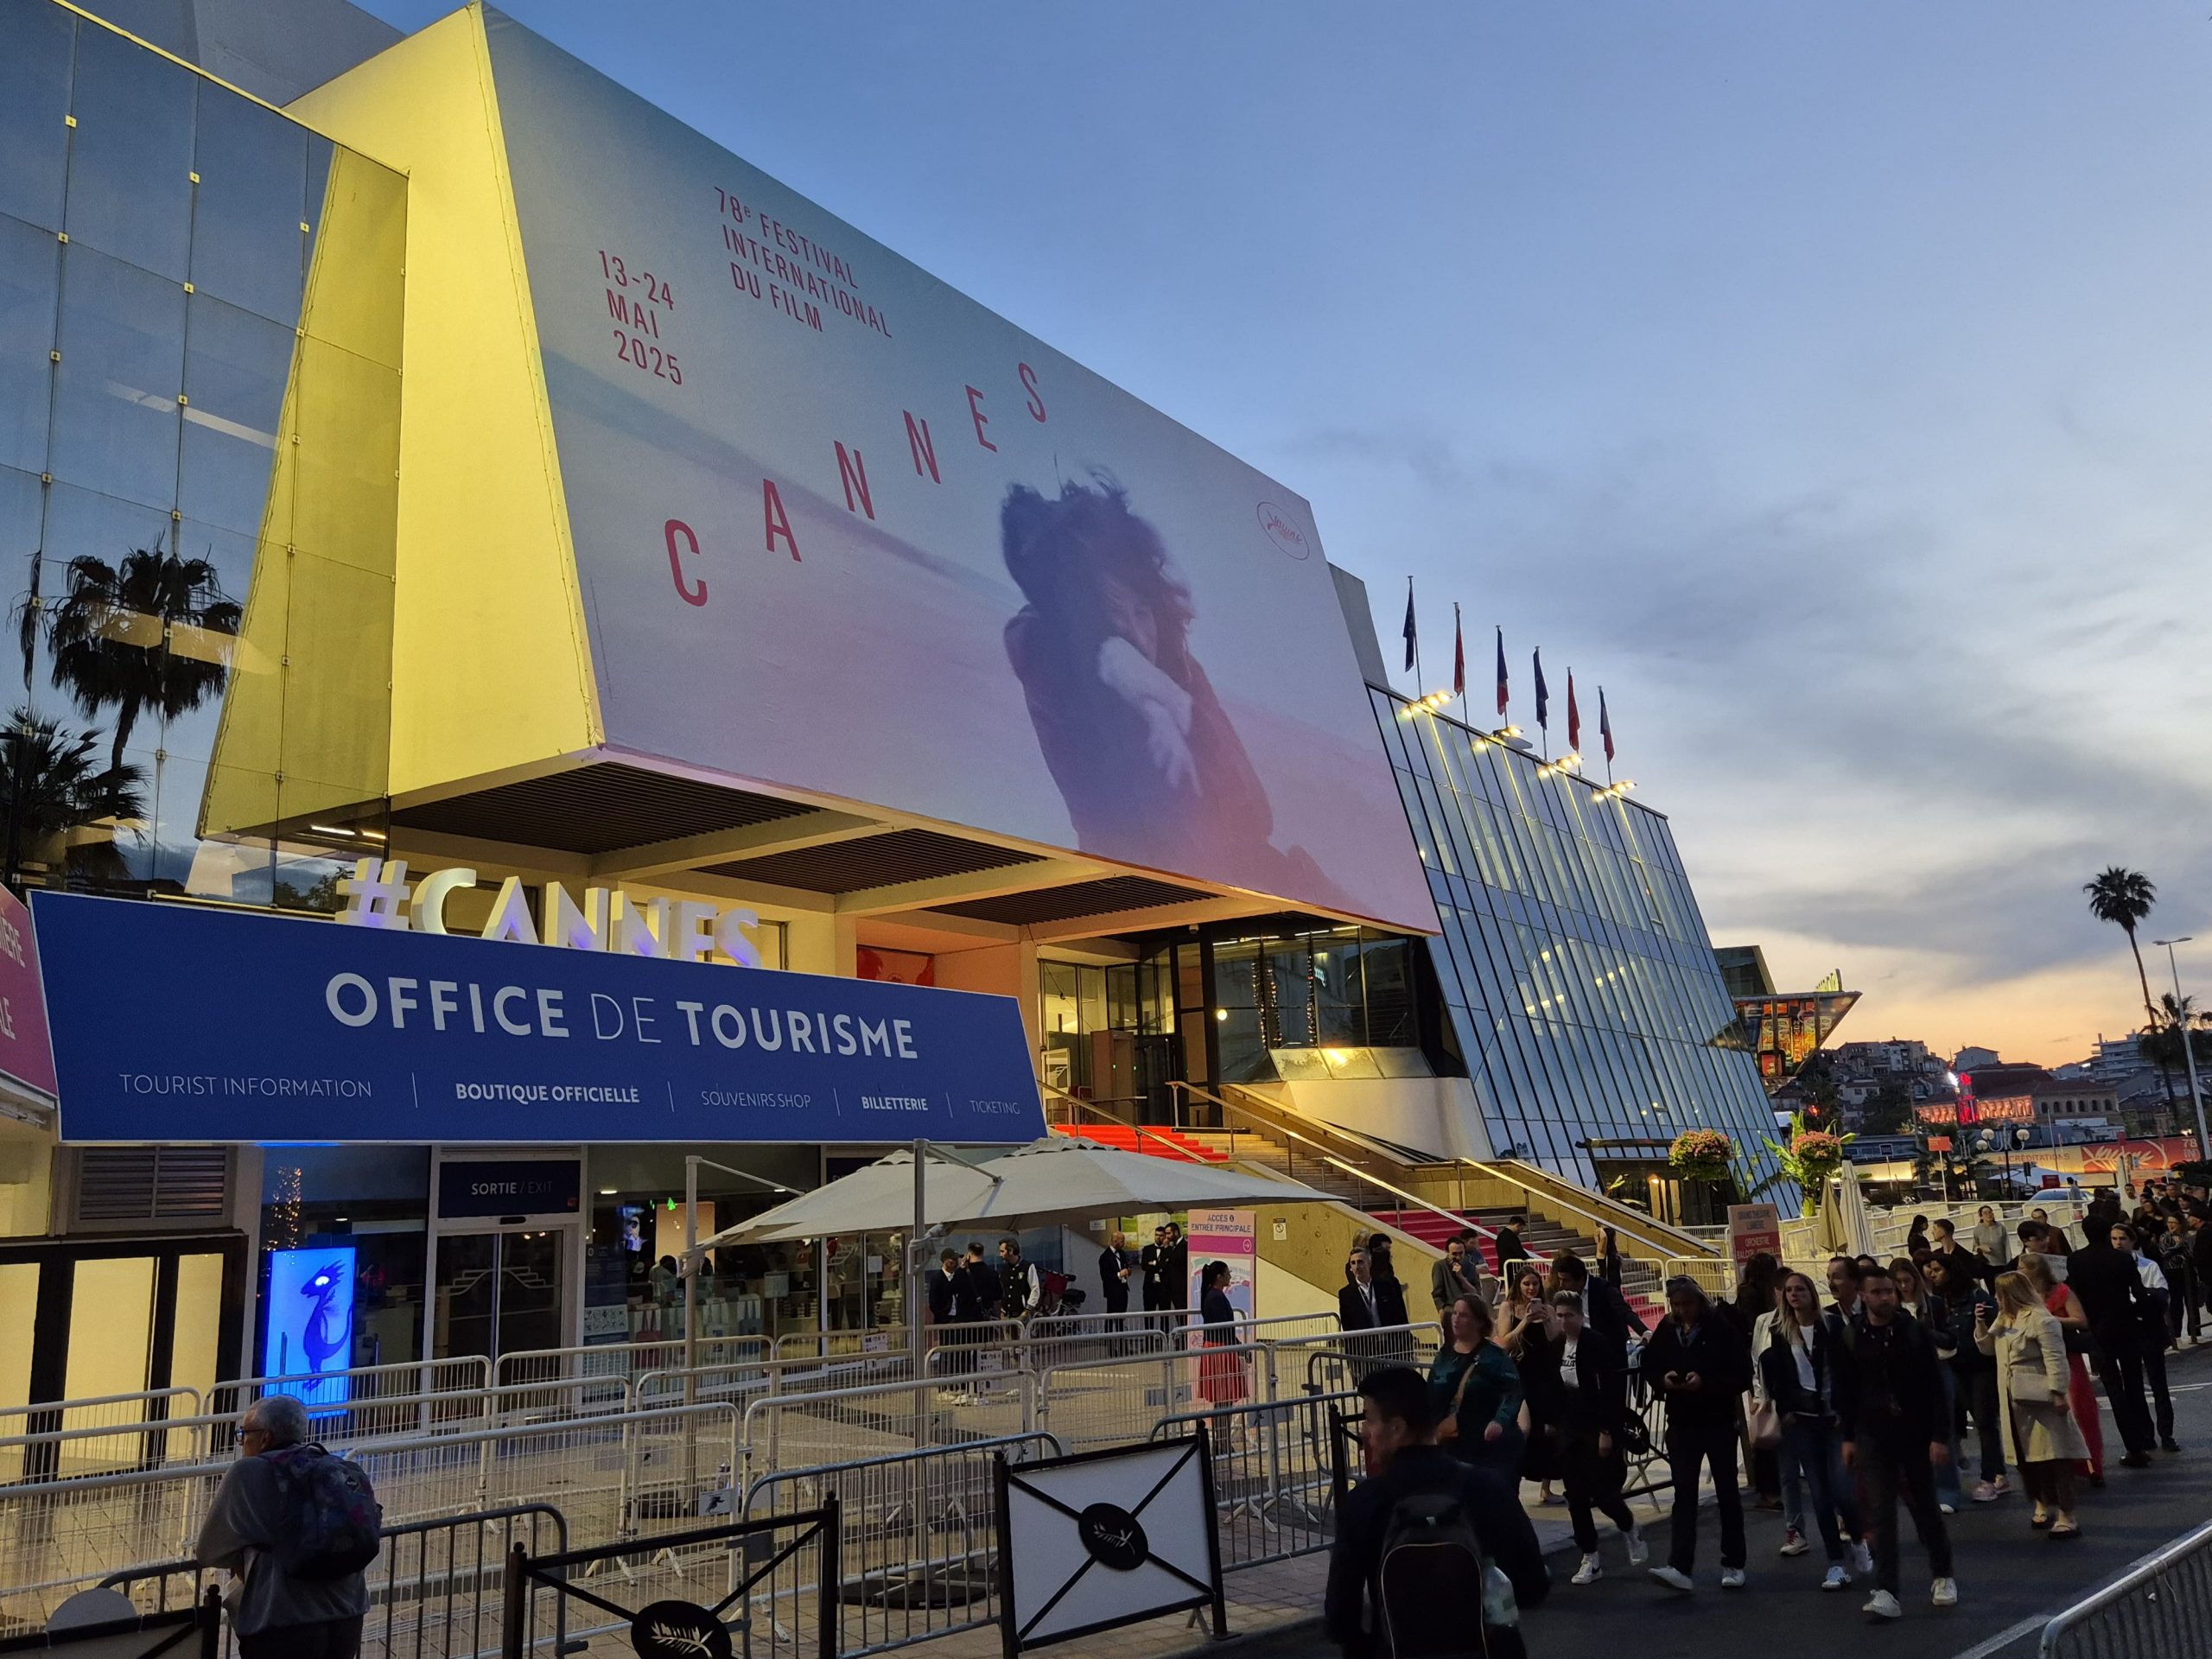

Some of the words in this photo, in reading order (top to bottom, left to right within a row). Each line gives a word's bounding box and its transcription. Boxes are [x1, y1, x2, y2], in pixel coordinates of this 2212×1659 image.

[598, 250, 675, 311] 13-24
[722, 224, 892, 338] INTERNATIONAL
[760, 213, 859, 289] FESTIVAL
[606, 289, 659, 340] MAI
[730, 262, 761, 300] DU
[772, 284, 823, 333] FILM
[613, 329, 683, 385] 2025
[664, 361, 1047, 607] CANNES
[335, 857, 762, 969] #CANNES
[325, 972, 569, 1038] OFFICE
[590, 993, 662, 1044] DE
[677, 1001, 918, 1059] TOURISME
[119, 1073, 217, 1096] TOURIST
[224, 1076, 372, 1099] INFORMATION
[456, 1082, 549, 1105] BOUTIQUE
[551, 1084, 639, 1104] OFFICIELLE
[702, 1089, 776, 1109] SOUVENIRS
[778, 1093, 811, 1109] SHOP
[861, 1095, 928, 1112] BILLETTERIE
[969, 1098, 1020, 1116] TICKETING
[471, 1182, 518, 1196] SORTIE
[528, 1180, 553, 1194] EXIT
[1215, 1224, 1251, 1233] PRINCIPALE
